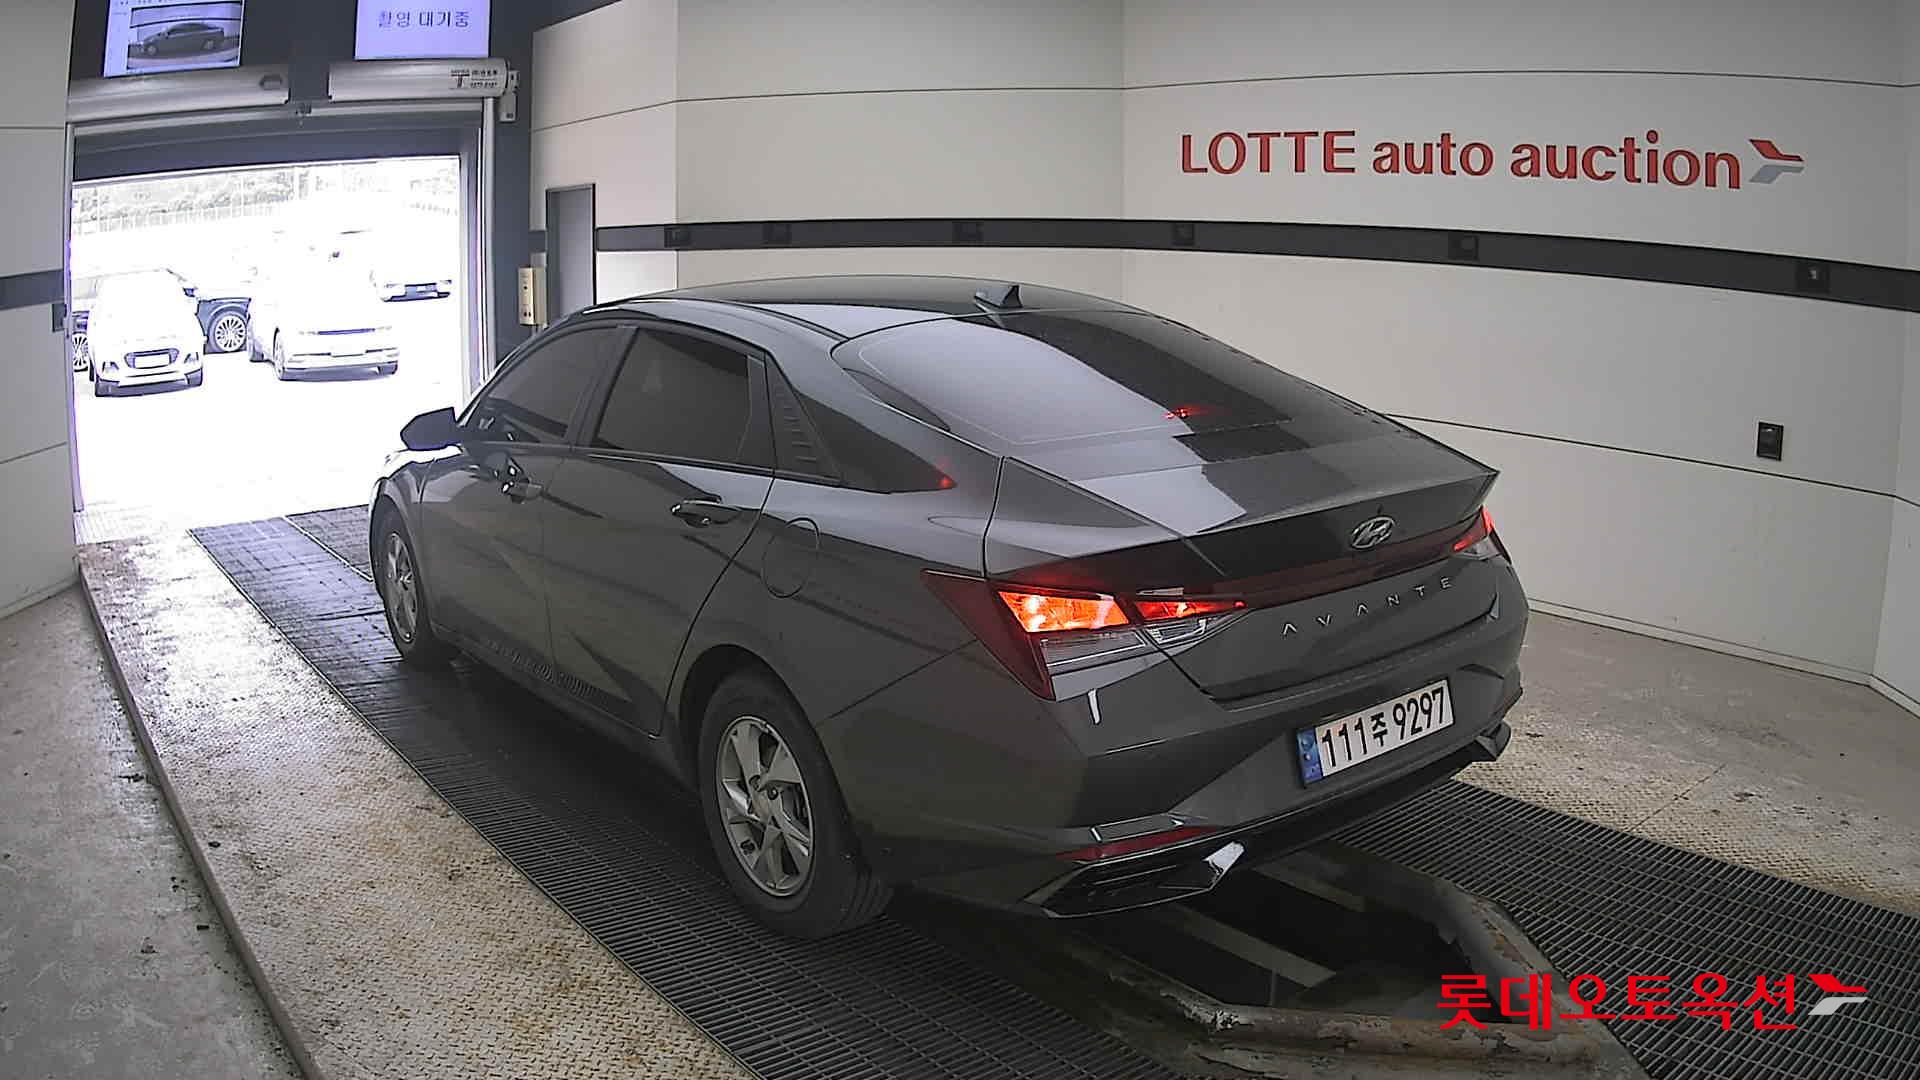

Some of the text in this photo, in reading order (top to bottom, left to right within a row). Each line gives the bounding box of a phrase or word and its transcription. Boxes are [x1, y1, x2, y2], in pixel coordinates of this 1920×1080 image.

[1182, 129, 1742, 190] LOTTE auto auction
[1281, 576, 1452, 636] AVANTE
